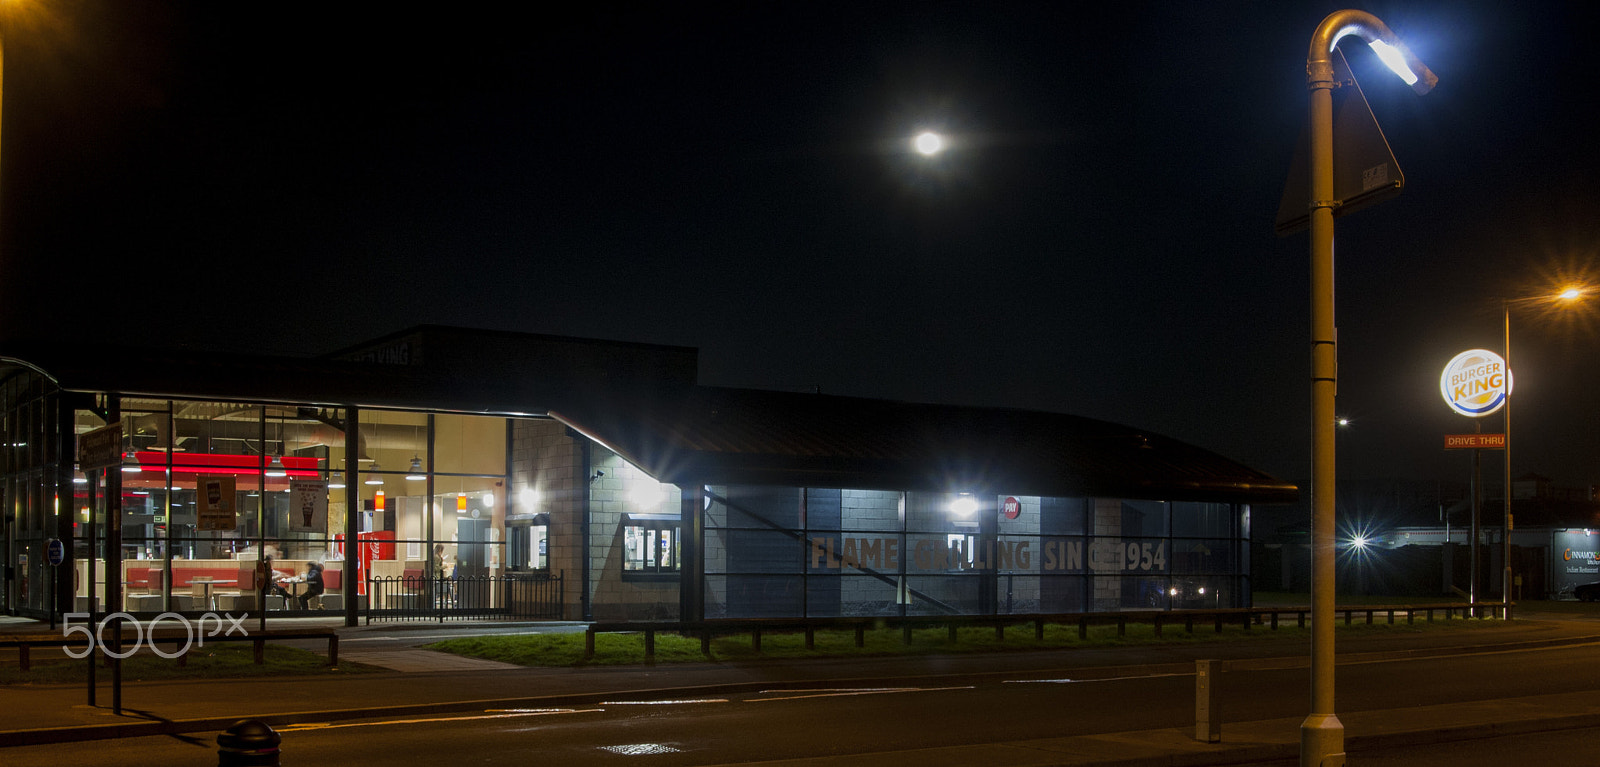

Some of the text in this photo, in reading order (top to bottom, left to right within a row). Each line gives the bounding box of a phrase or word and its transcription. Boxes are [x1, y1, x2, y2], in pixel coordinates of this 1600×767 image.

[1452, 363, 1501, 386] BURGER
[1454, 373, 1503, 402] KING
[1448, 436, 1504, 446] DRIVE THRU
[1004, 502, 1017, 513] PAY
[811, 537, 899, 569] FLAME
[914, 538, 1031, 571] GRILLING
[1115, 540, 1166, 571] 1954
